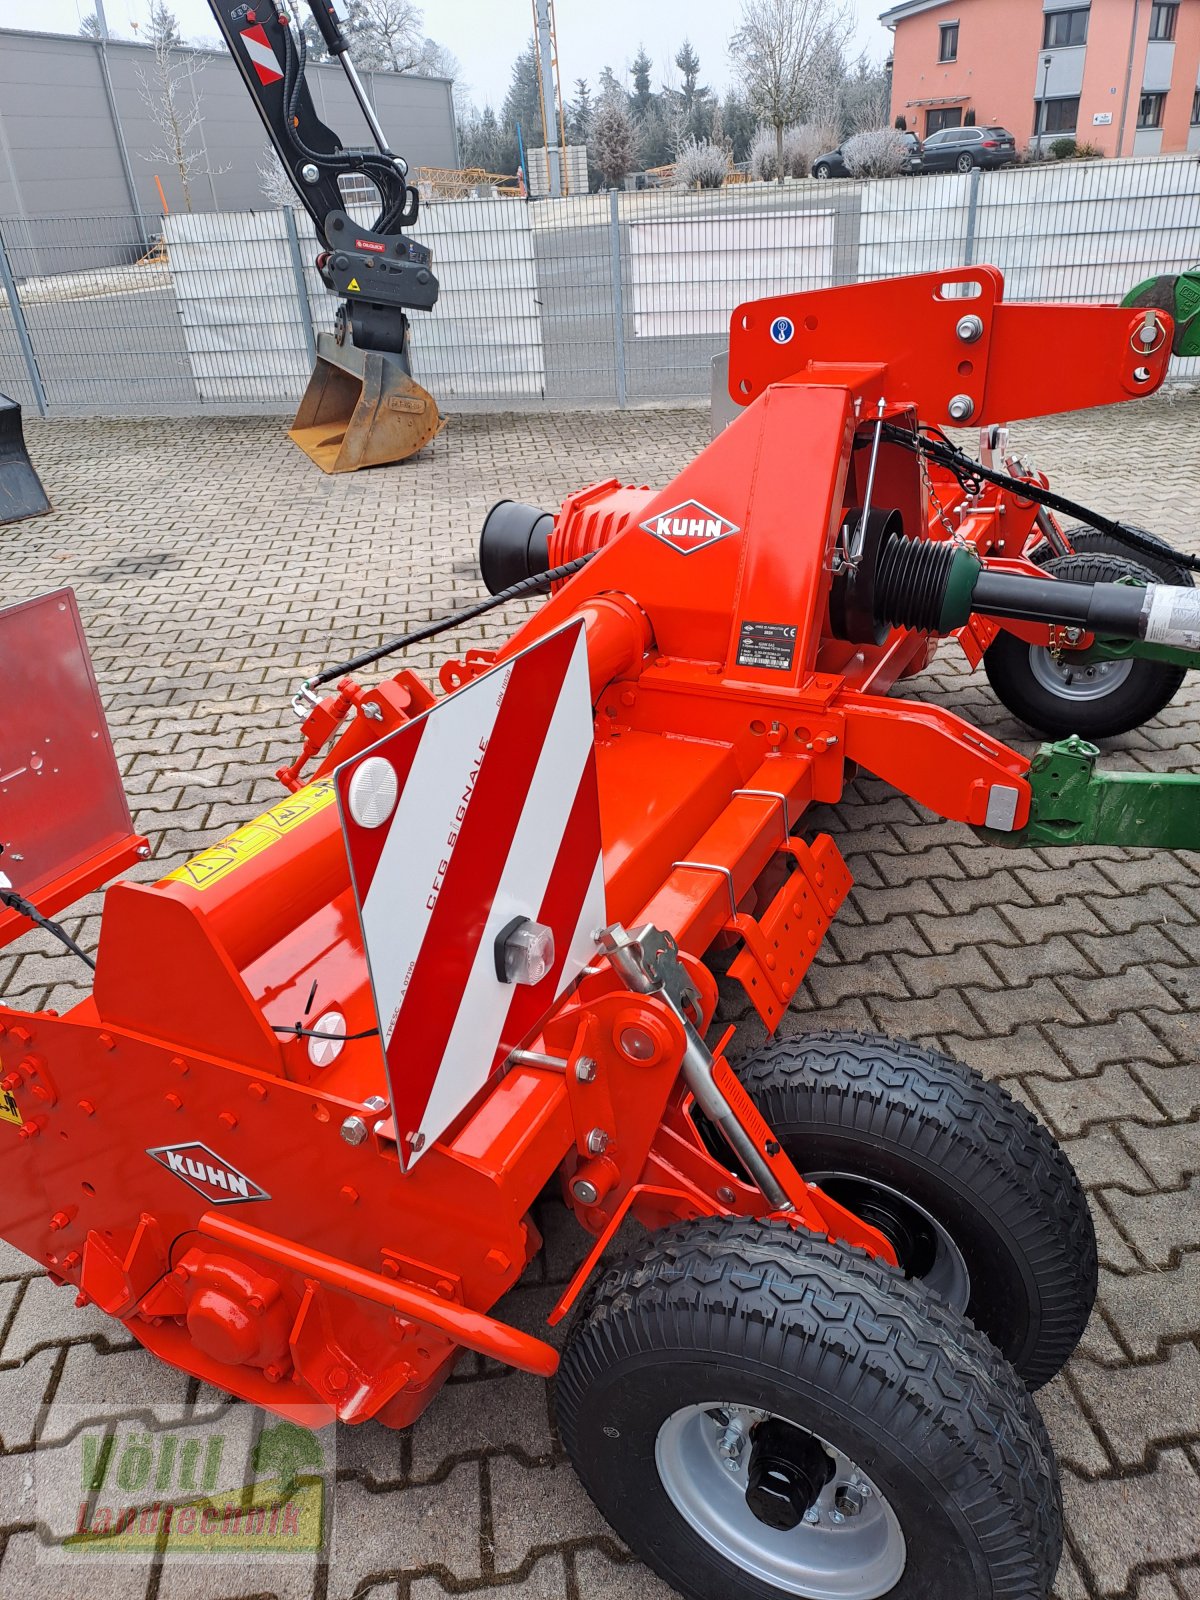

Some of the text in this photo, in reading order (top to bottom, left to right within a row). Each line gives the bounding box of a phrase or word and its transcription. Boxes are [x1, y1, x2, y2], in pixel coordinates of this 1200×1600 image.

[656, 517, 722, 538] KUHN
[783, 627, 796, 637] CE
[495, 691, 504, 707] DIN
[426, 859, 449, 910] CFG
[166, 1150, 249, 1198] KUHN
